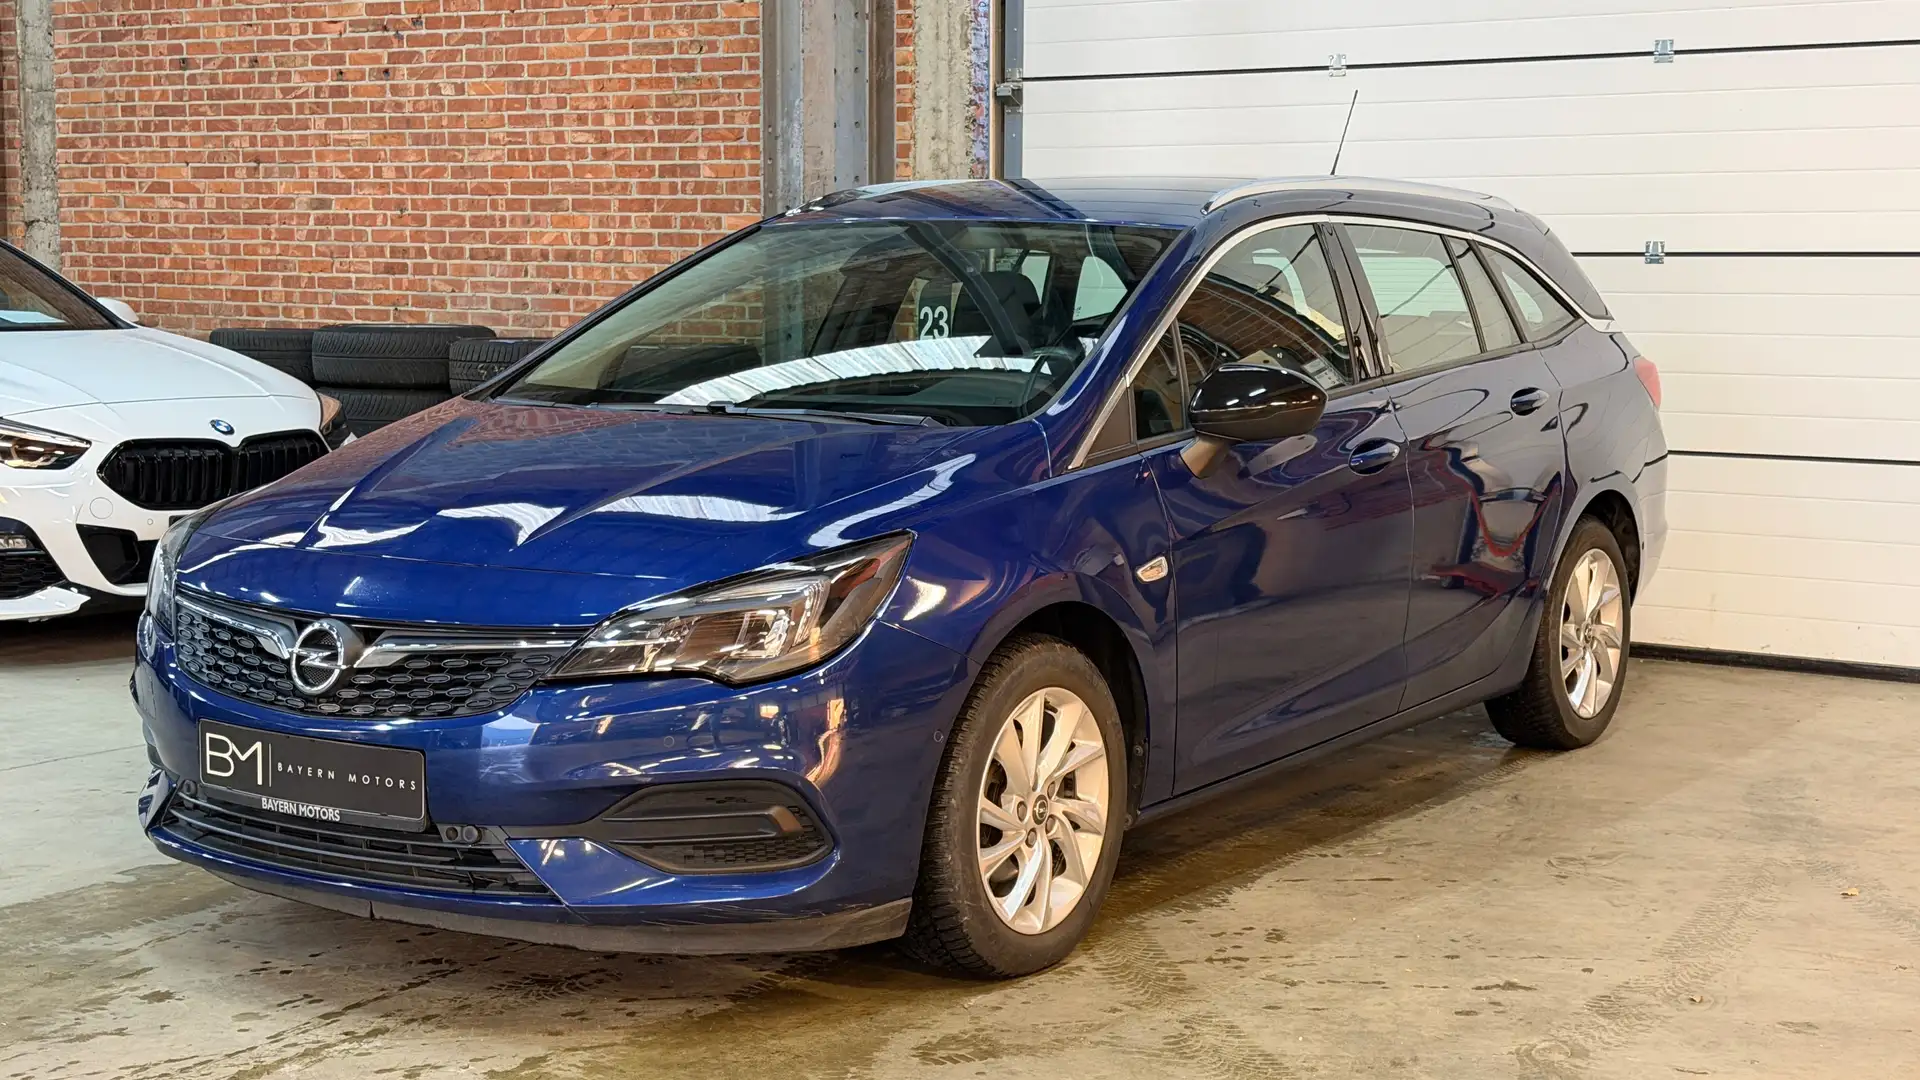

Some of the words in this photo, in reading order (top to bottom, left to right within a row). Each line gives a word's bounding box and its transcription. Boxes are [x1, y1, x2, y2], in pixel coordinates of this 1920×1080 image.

[920, 306, 949, 340] 23
[206, 732, 263, 786] BM
[277, 762, 335, 780] BAYERN
[348, 773, 416, 791] MOTORS
[261, 797, 297, 816] BAYERN
[299, 804, 341, 822] MOTORS
